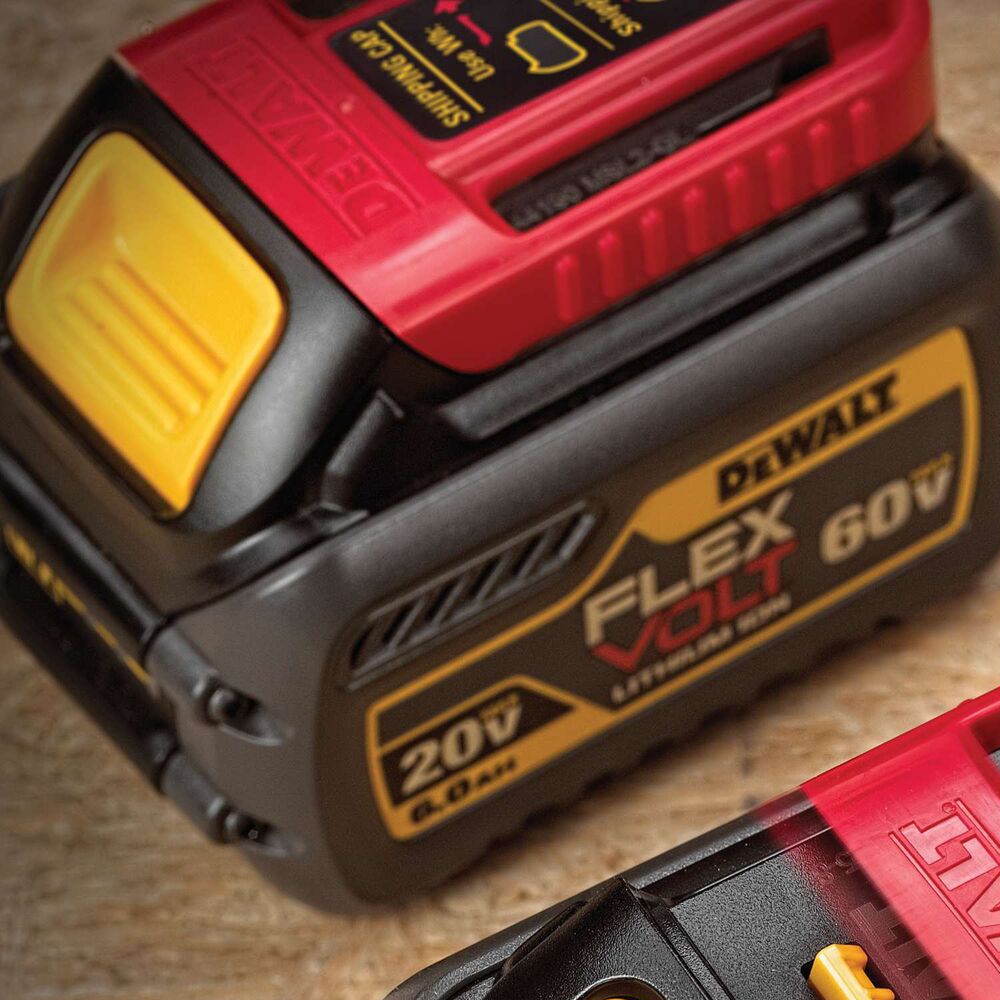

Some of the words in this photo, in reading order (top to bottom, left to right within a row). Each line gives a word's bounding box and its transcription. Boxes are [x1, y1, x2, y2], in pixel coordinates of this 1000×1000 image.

[350, 29, 394, 59] CAP
[457, 49, 496, 82] Use
[381, 54, 471, 128] SHIPPING
[716, 371, 897, 501] DEWALT
[583, 489, 795, 645] FLEX
[592, 539, 798, 672] VOLT
[611, 625, 734, 703] LITHIUM
